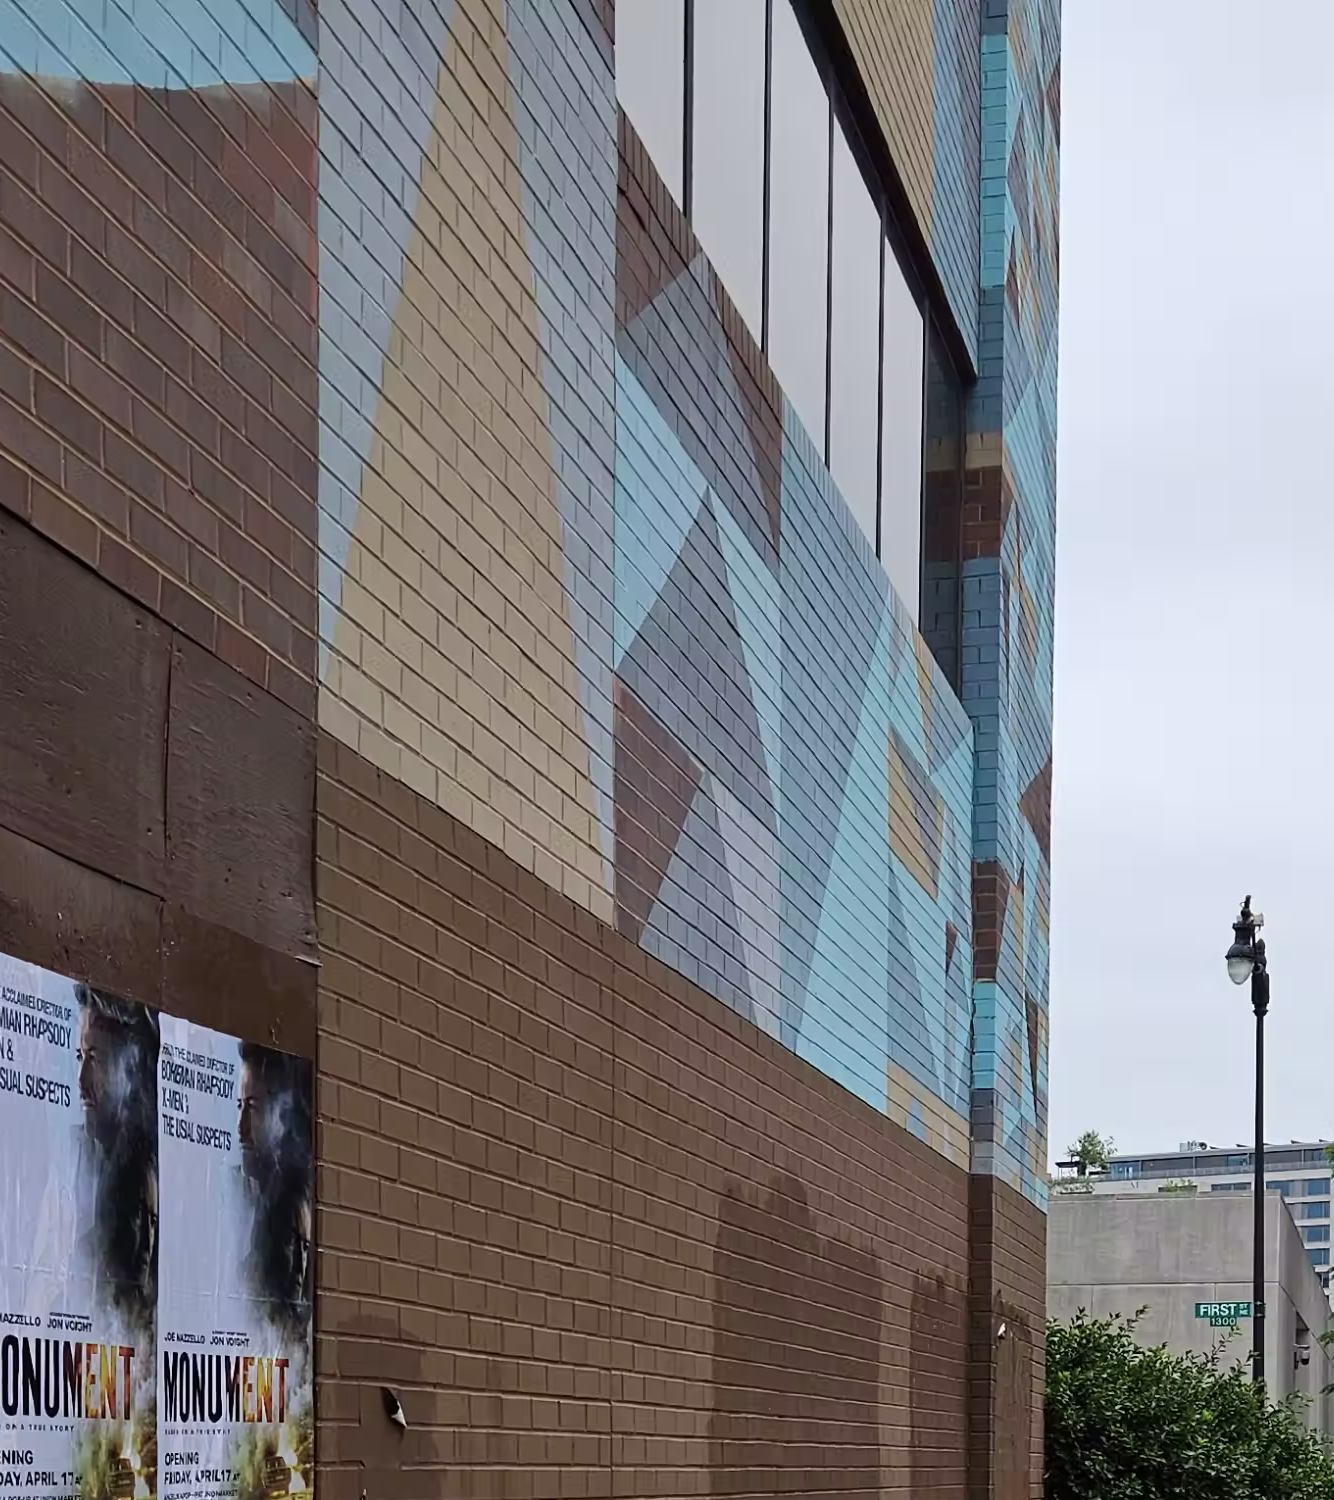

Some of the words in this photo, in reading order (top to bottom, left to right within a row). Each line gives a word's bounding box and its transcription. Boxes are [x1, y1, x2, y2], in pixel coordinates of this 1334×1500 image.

[1199, 1304, 1237, 1315] FIRST
[1211, 1317, 1236, 1326] 1300
[164, 1351, 291, 1423] MONUMENT
[26, 1472, 57, 1486] APRIL
